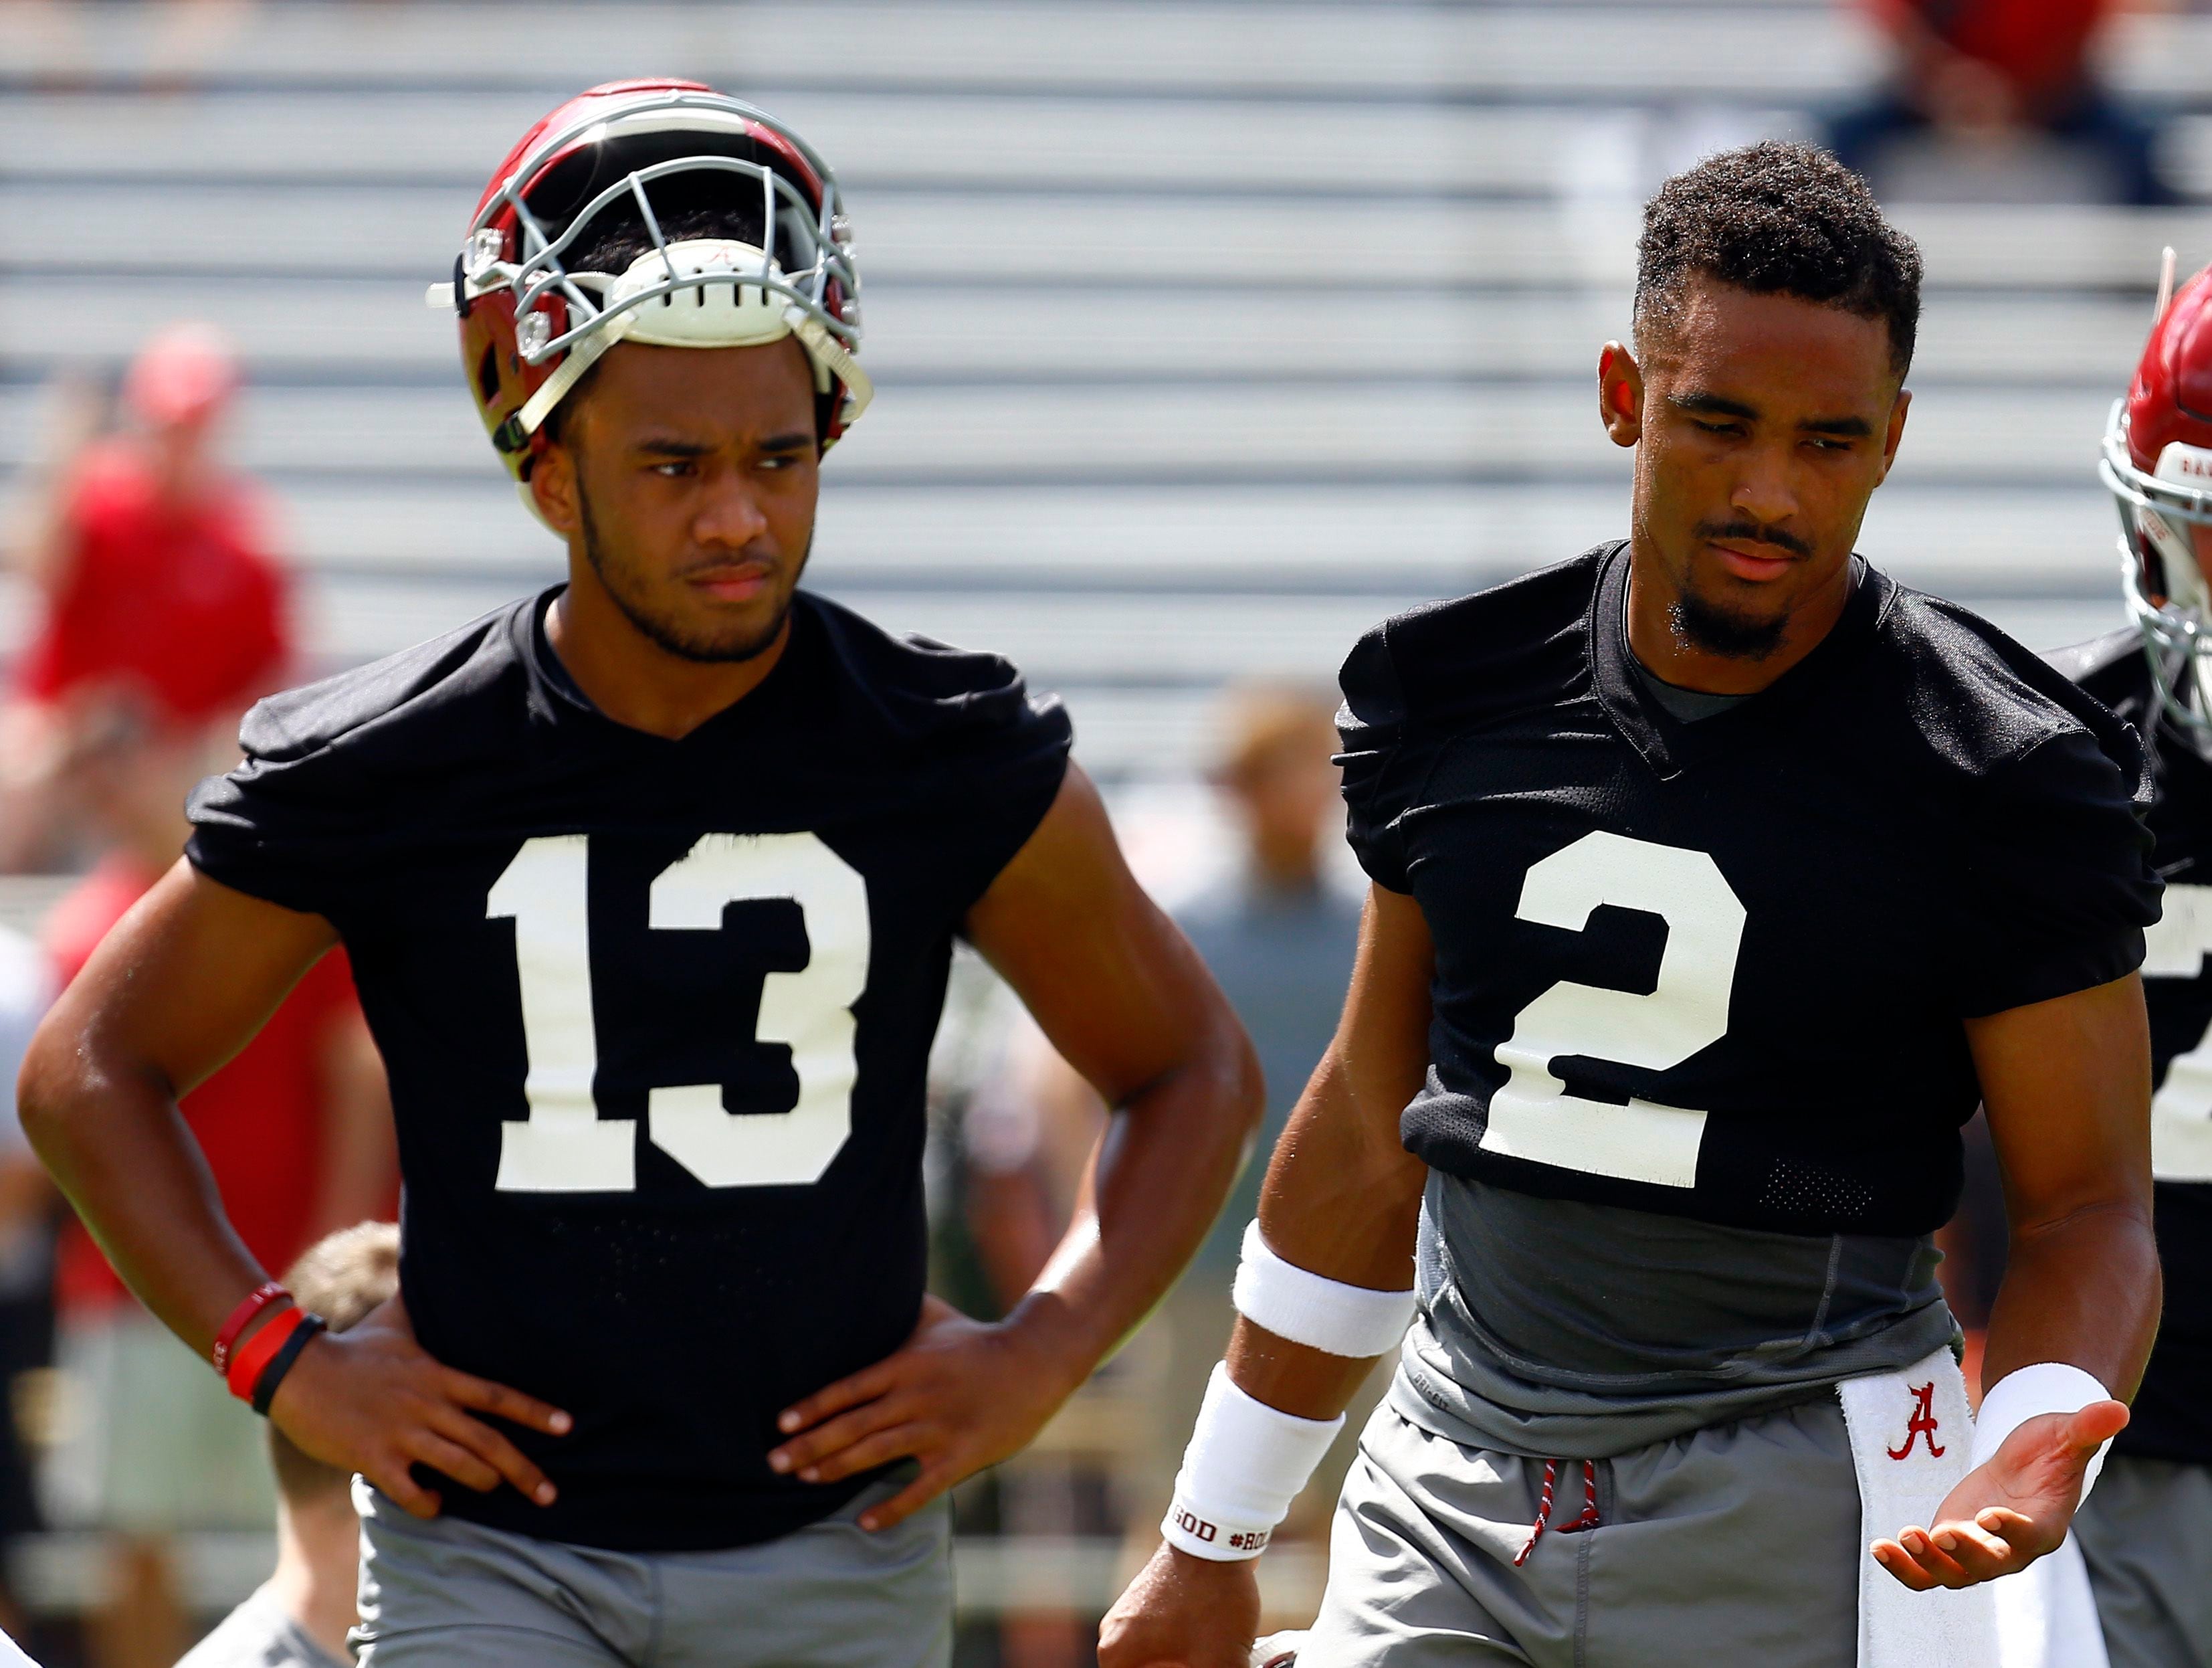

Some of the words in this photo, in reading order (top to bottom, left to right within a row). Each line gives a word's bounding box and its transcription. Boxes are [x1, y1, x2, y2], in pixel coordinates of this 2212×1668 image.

[486, 831, 872, 1193] 13
[1478, 830, 1747, 1189] 2
[1172, 1504, 1217, 1542] GOD
[1886, 1381, 1946, 1461] A
